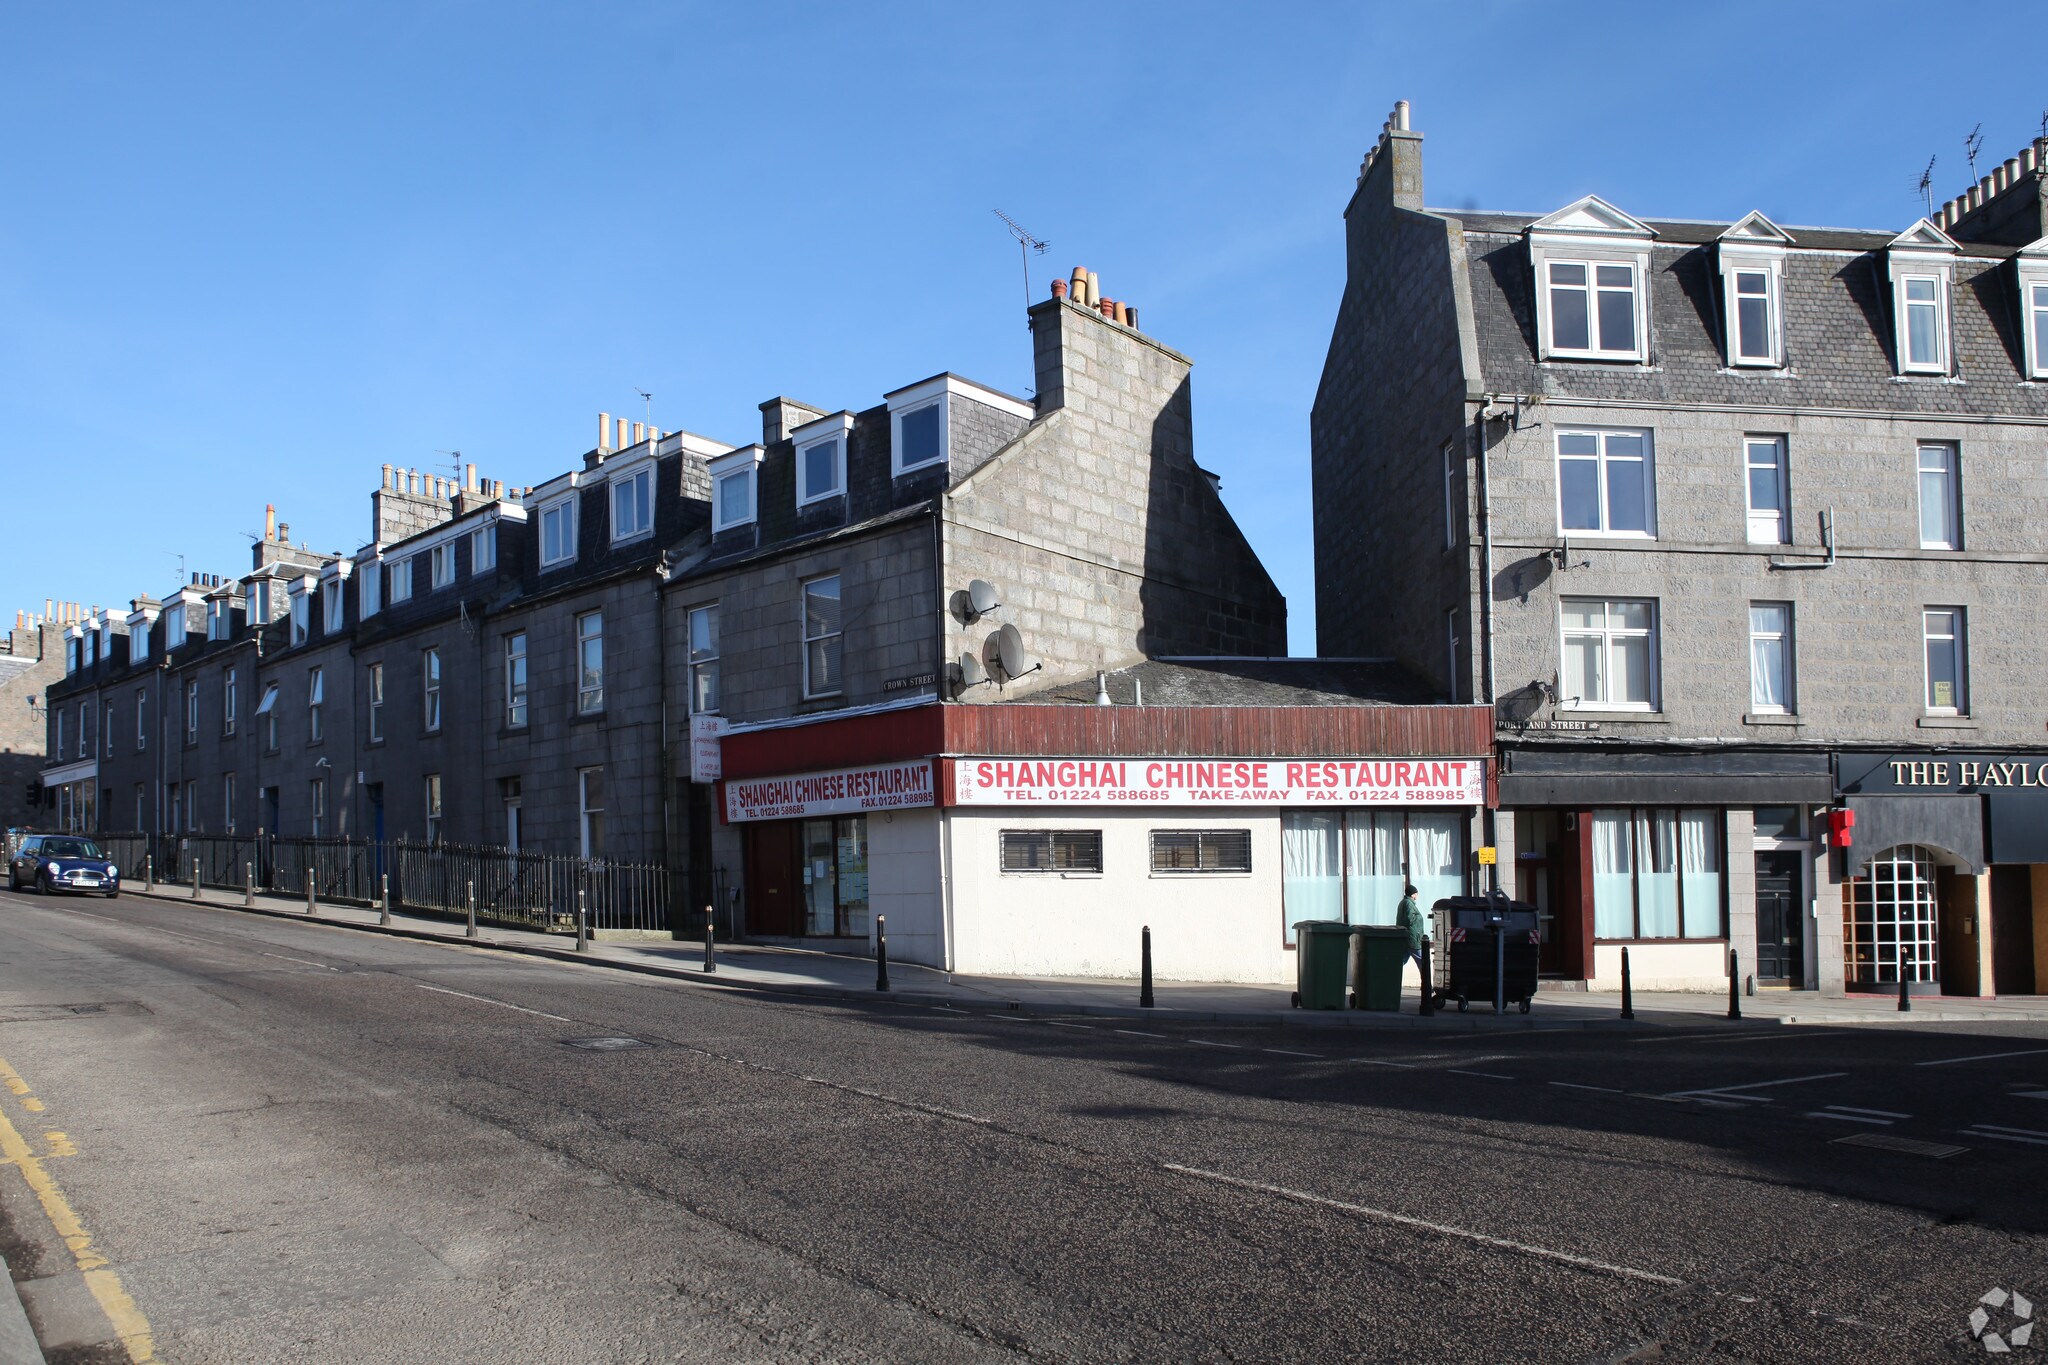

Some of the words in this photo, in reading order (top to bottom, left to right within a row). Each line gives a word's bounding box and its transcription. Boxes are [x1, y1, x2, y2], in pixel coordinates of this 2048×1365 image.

[883, 679, 907, 690] CROWN
[909, 674, 937, 685] STREET
[1550, 721, 1587, 730] STREET
[977, 761, 1126, 788] SHANGHAI
[1146, 763, 1268, 788] CHINESE
[1287, 762, 1467, 788] RESTAURANT
[1889, 761, 1950, 786] THE
[739, 781, 794, 808] SHANGHAI
[795, 775, 844, 803] CHINESE
[847, 765, 929, 797] RESTAURANT
[861, 798, 878, 808] FAX.
[879, 795, 902, 807] 01224
[904, 792, 934, 804] 588985
[1004, 790, 1042, 800] TEL.
[1048, 790, 1101, 801] 01224
[1107, 790, 1170, 801] 588685
[1188, 790, 1291, 800] TAKE-AWAY
[1306, 790, 1343, 800] FAX.
[1349, 790, 1400, 800] 01224
[1405, 790, 1465, 800] 588985
[745, 809, 759, 818] TEL.
[760, 807, 780, 817] 01224
[781, 805, 805, 815] 588685
